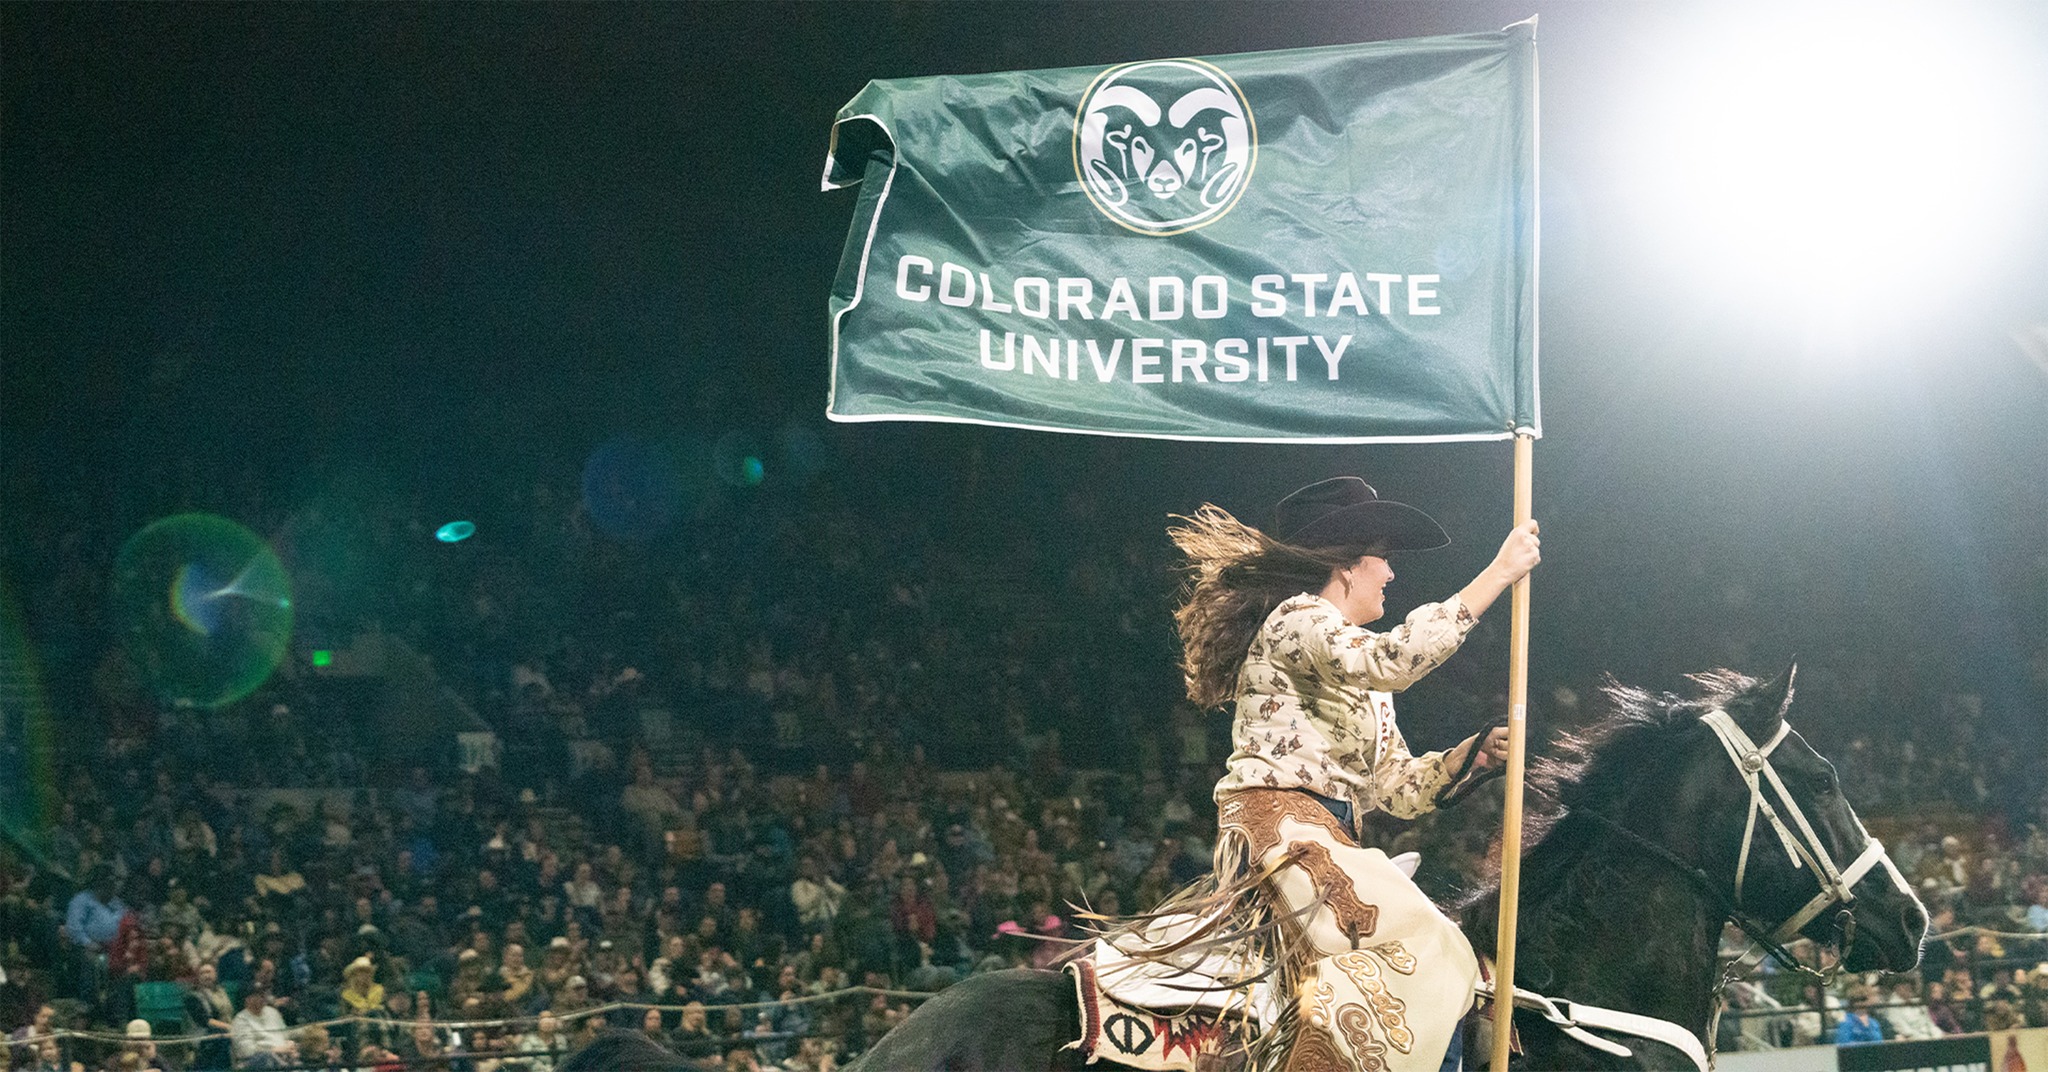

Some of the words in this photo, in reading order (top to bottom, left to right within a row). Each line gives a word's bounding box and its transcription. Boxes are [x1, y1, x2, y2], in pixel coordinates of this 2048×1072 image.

[895, 254, 1229, 321] COLORADO
[1251, 273, 1442, 317] STATE
[979, 331, 1354, 384] UNIVERSITY
[1336, 953, 1410, 1050] Rodeo
